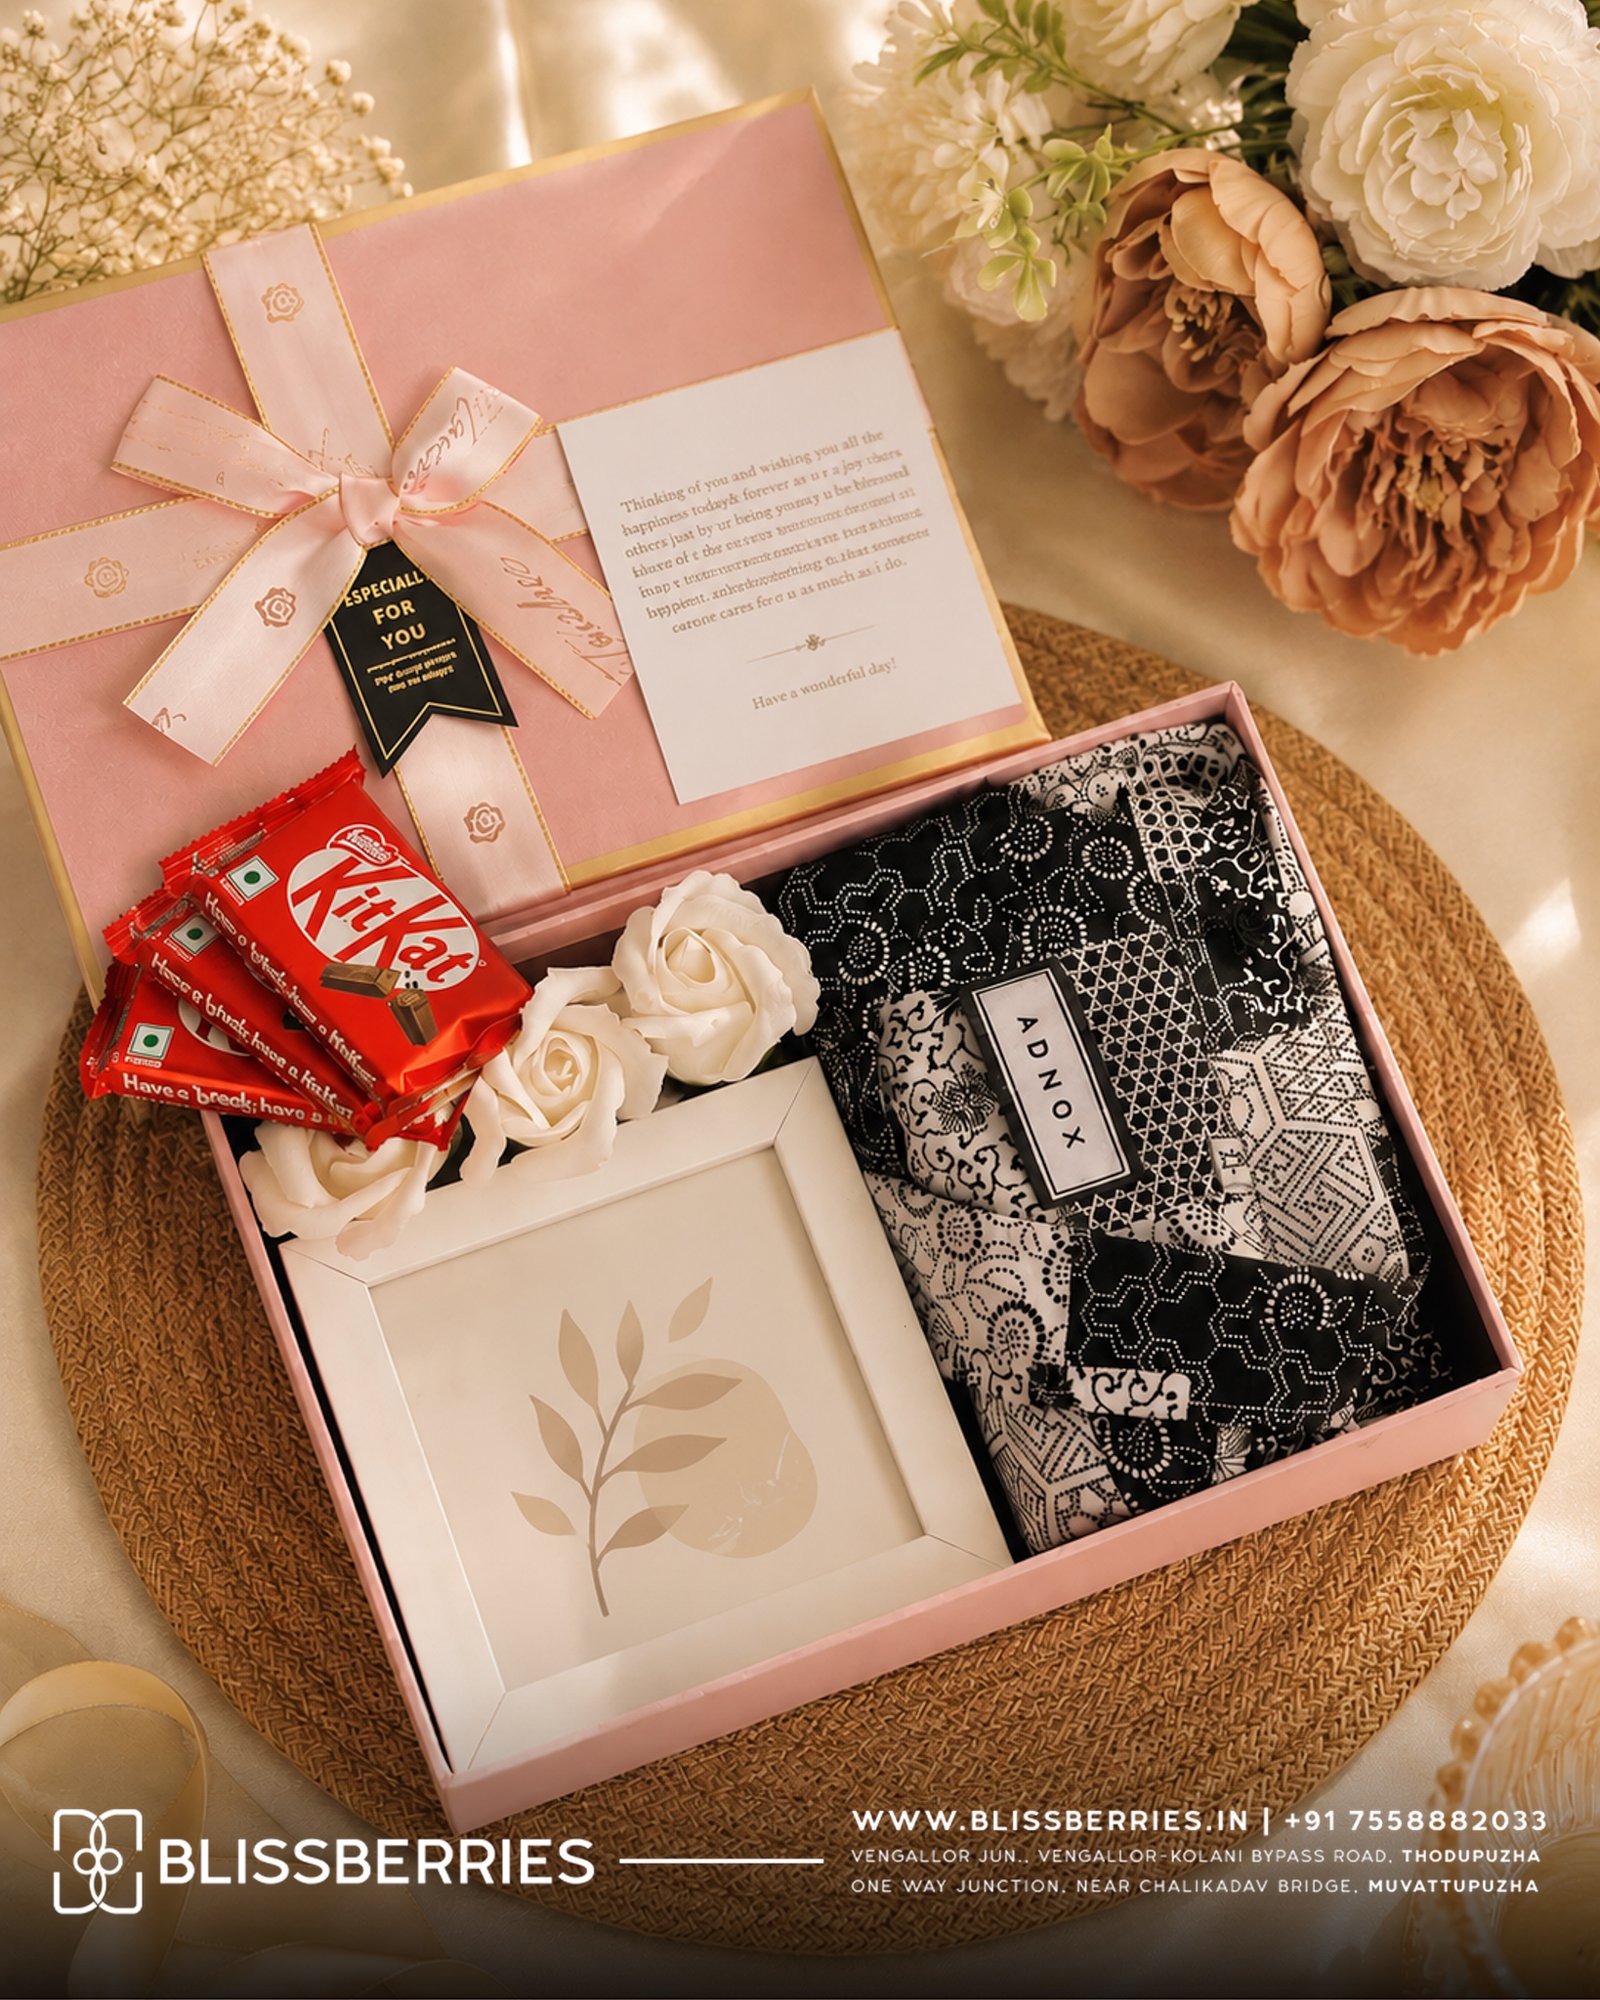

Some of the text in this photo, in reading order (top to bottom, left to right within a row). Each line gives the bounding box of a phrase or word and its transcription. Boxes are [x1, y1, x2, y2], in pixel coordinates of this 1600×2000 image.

[620, 430, 884, 513] Thinking of you and wishing you all the
[743, 480, 789, 501] forever
[344, 570, 427, 607] ESPECIALL
[372, 599, 416, 625] FOR
[380, 623, 427, 650] YOU
[752, 657, 897, 710] Have a wonderful day!
[291, 855, 474, 983] KitKat
[1017, 1016, 1086, 1149] ADNOX
